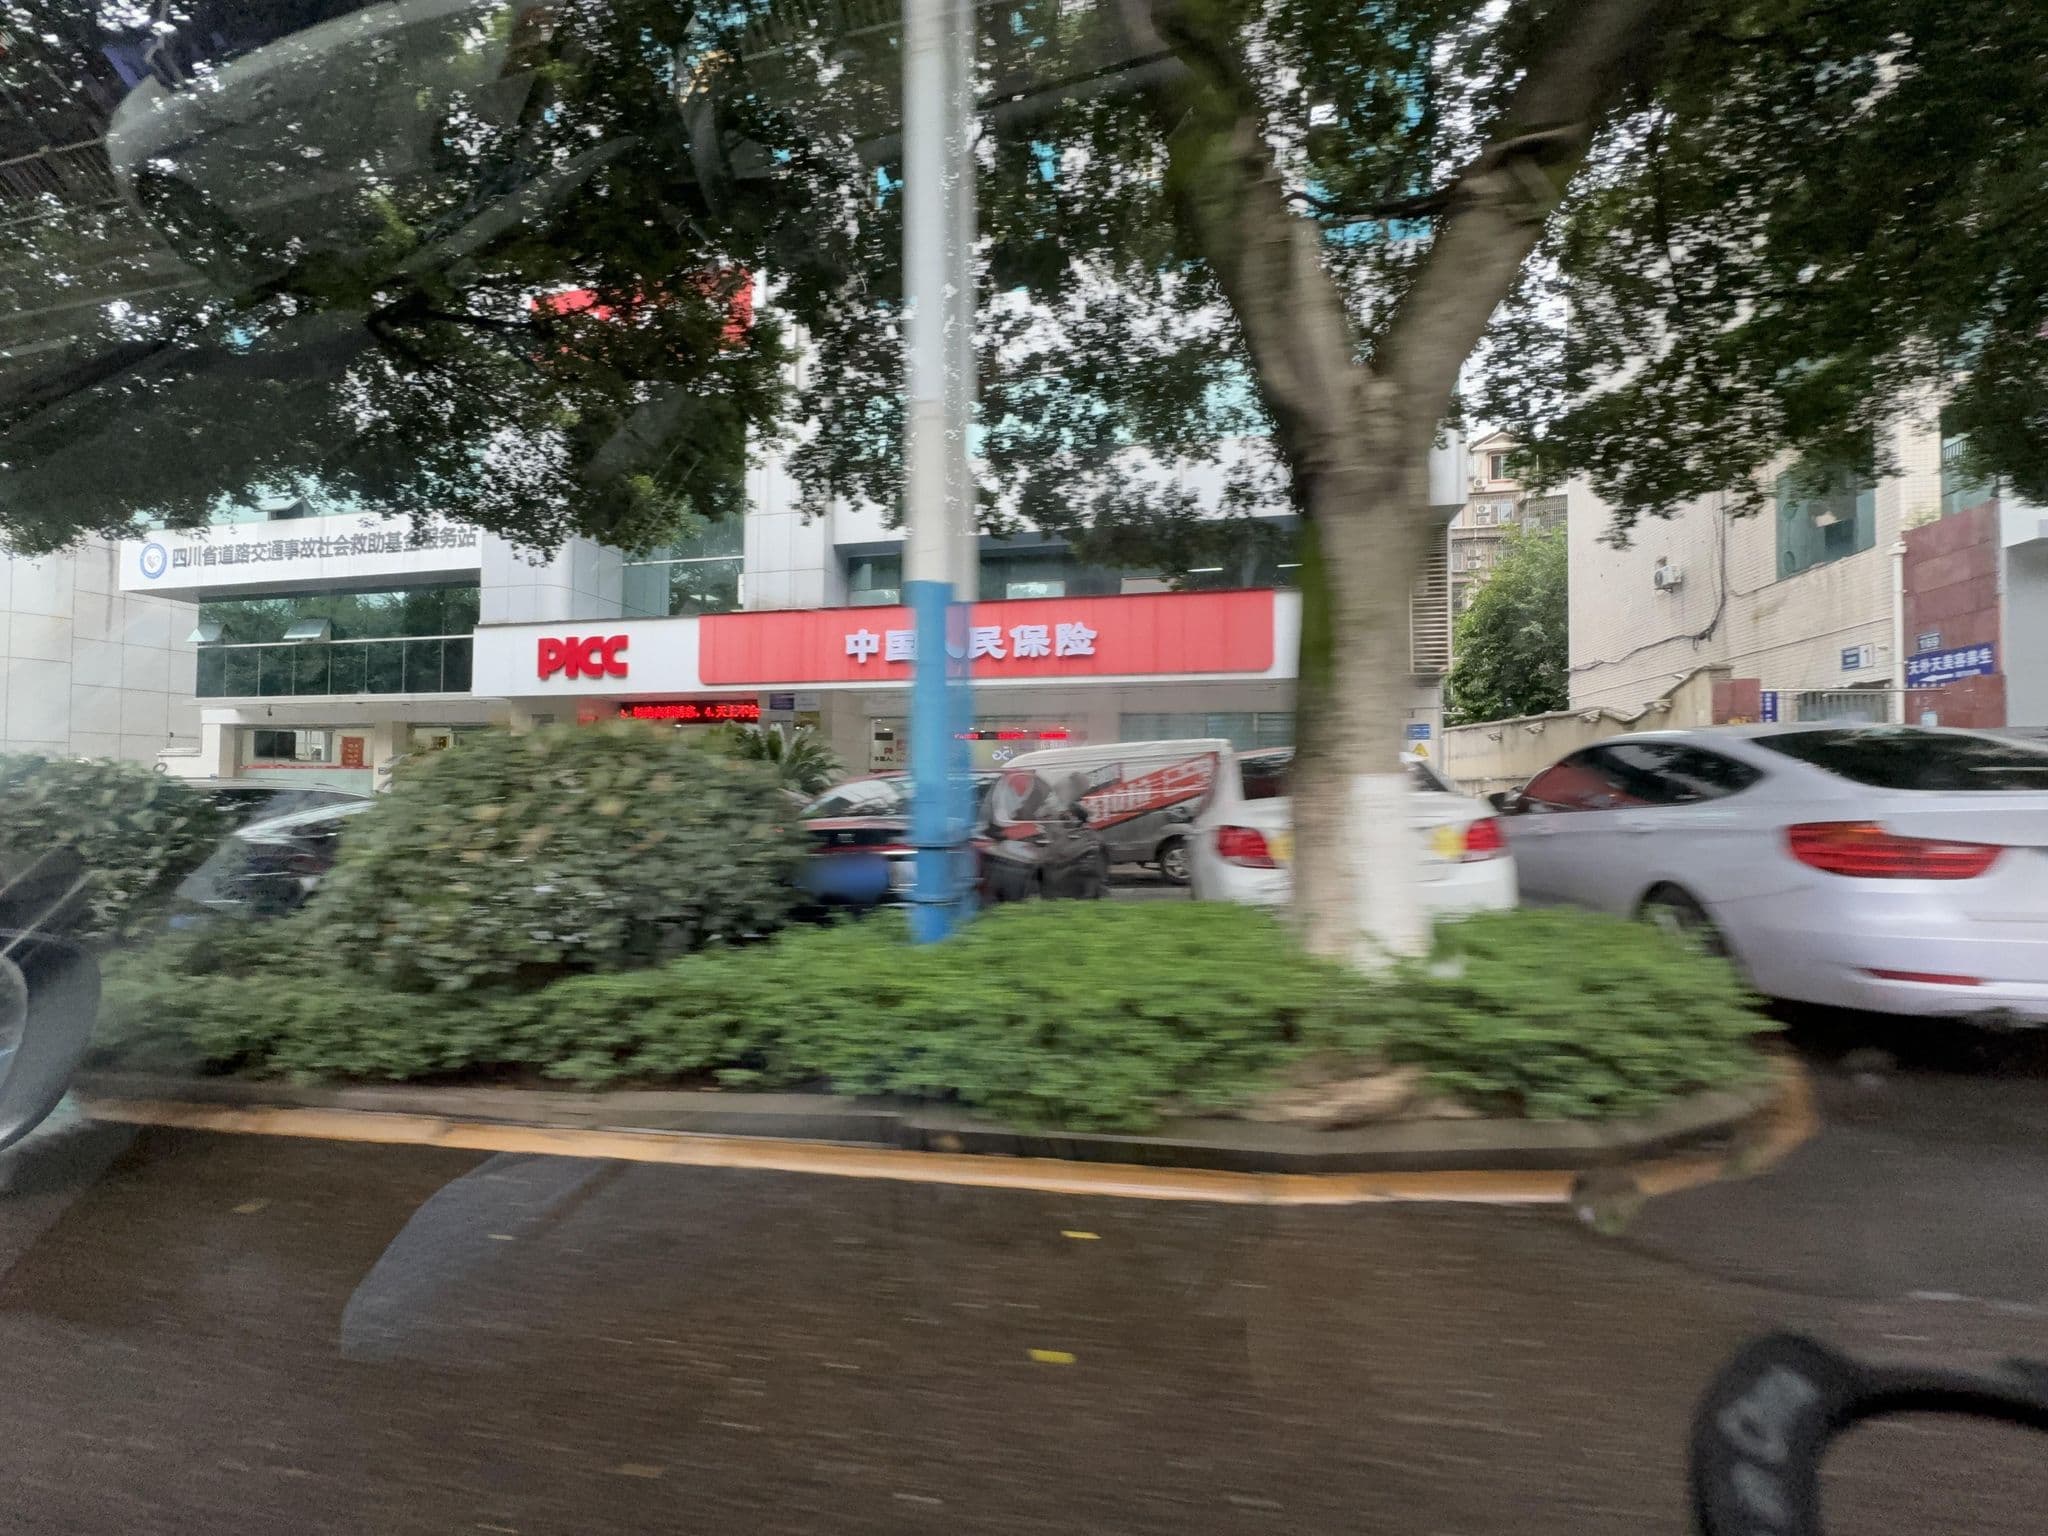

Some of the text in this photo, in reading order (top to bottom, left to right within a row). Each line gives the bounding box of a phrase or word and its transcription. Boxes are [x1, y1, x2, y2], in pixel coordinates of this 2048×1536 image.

[537, 634, 629, 681] PICC
[844, 621, 1098, 664] 中国民保险
